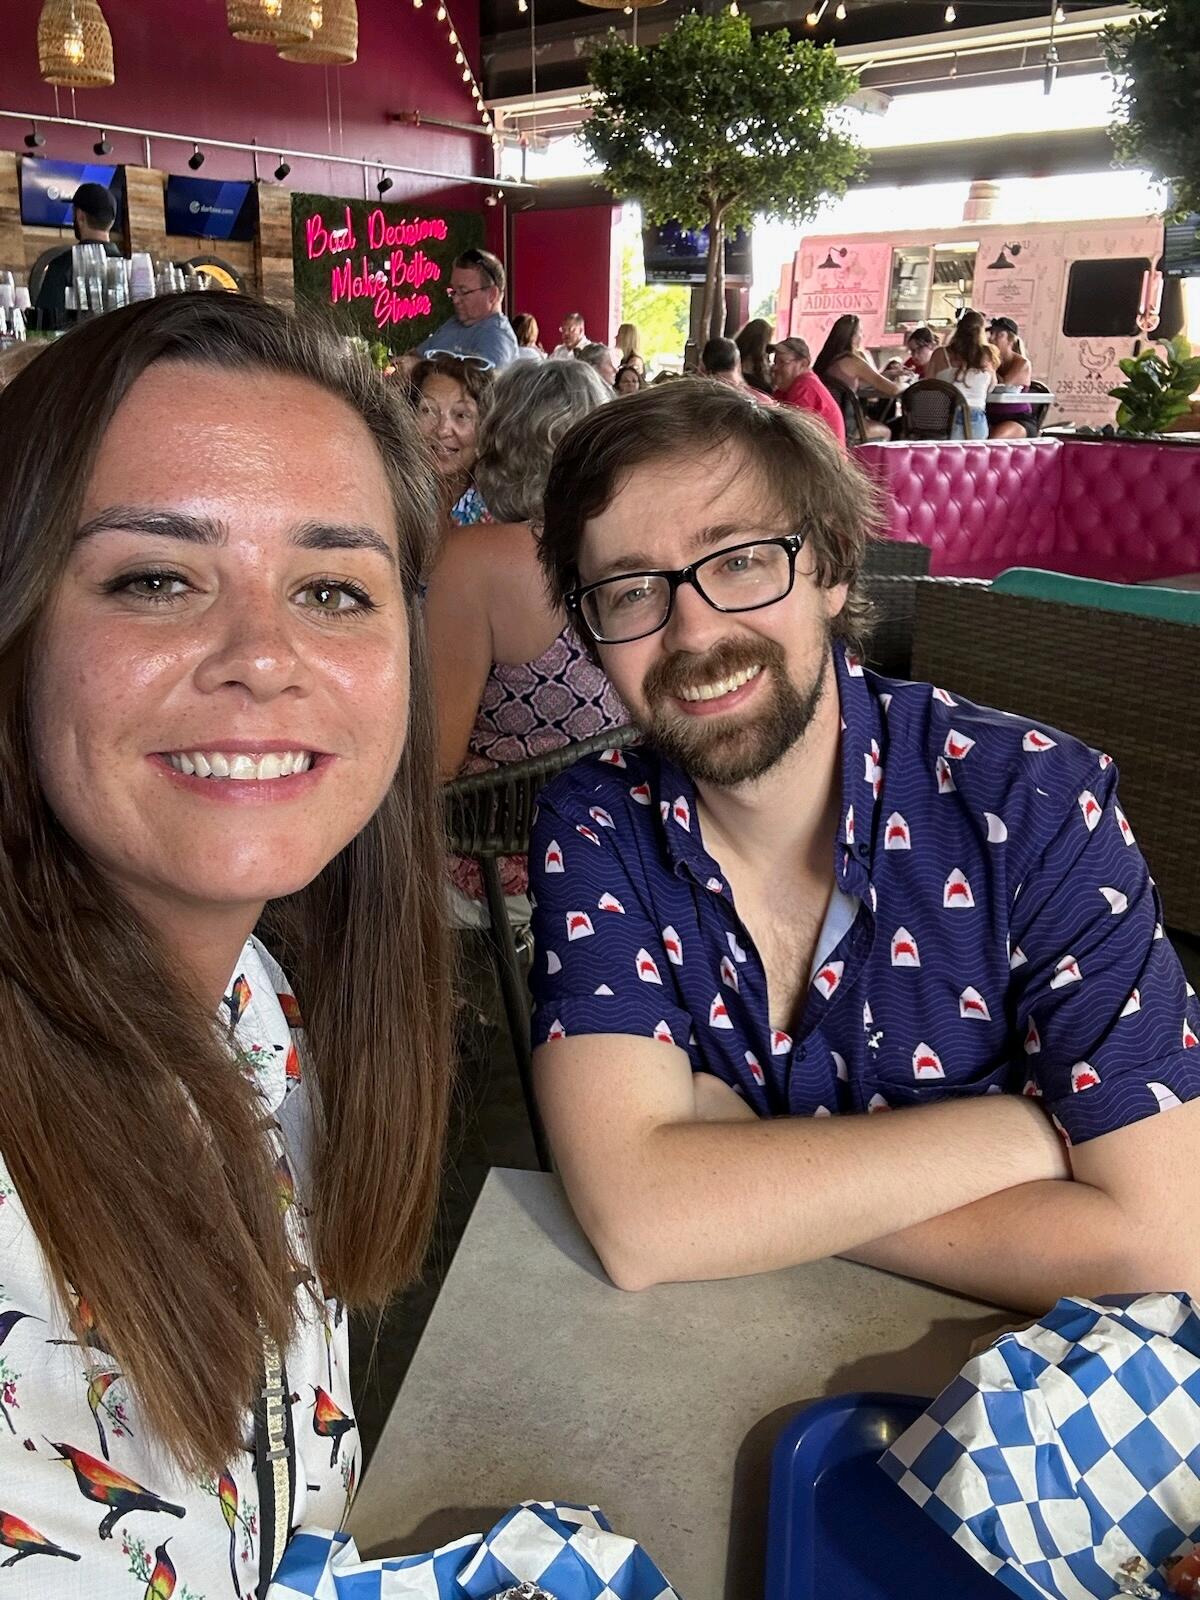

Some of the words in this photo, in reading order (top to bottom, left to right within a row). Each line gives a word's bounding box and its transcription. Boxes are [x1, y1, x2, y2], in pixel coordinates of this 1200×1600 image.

[305, 206, 356, 260] Bad
[368, 209, 448, 249] Decisions
[331, 255, 388, 304] Make
[390, 250, 440, 289] Better
[374, 289, 431, 329] Stories
[804, 294, 874, 310] ADDISON'S
